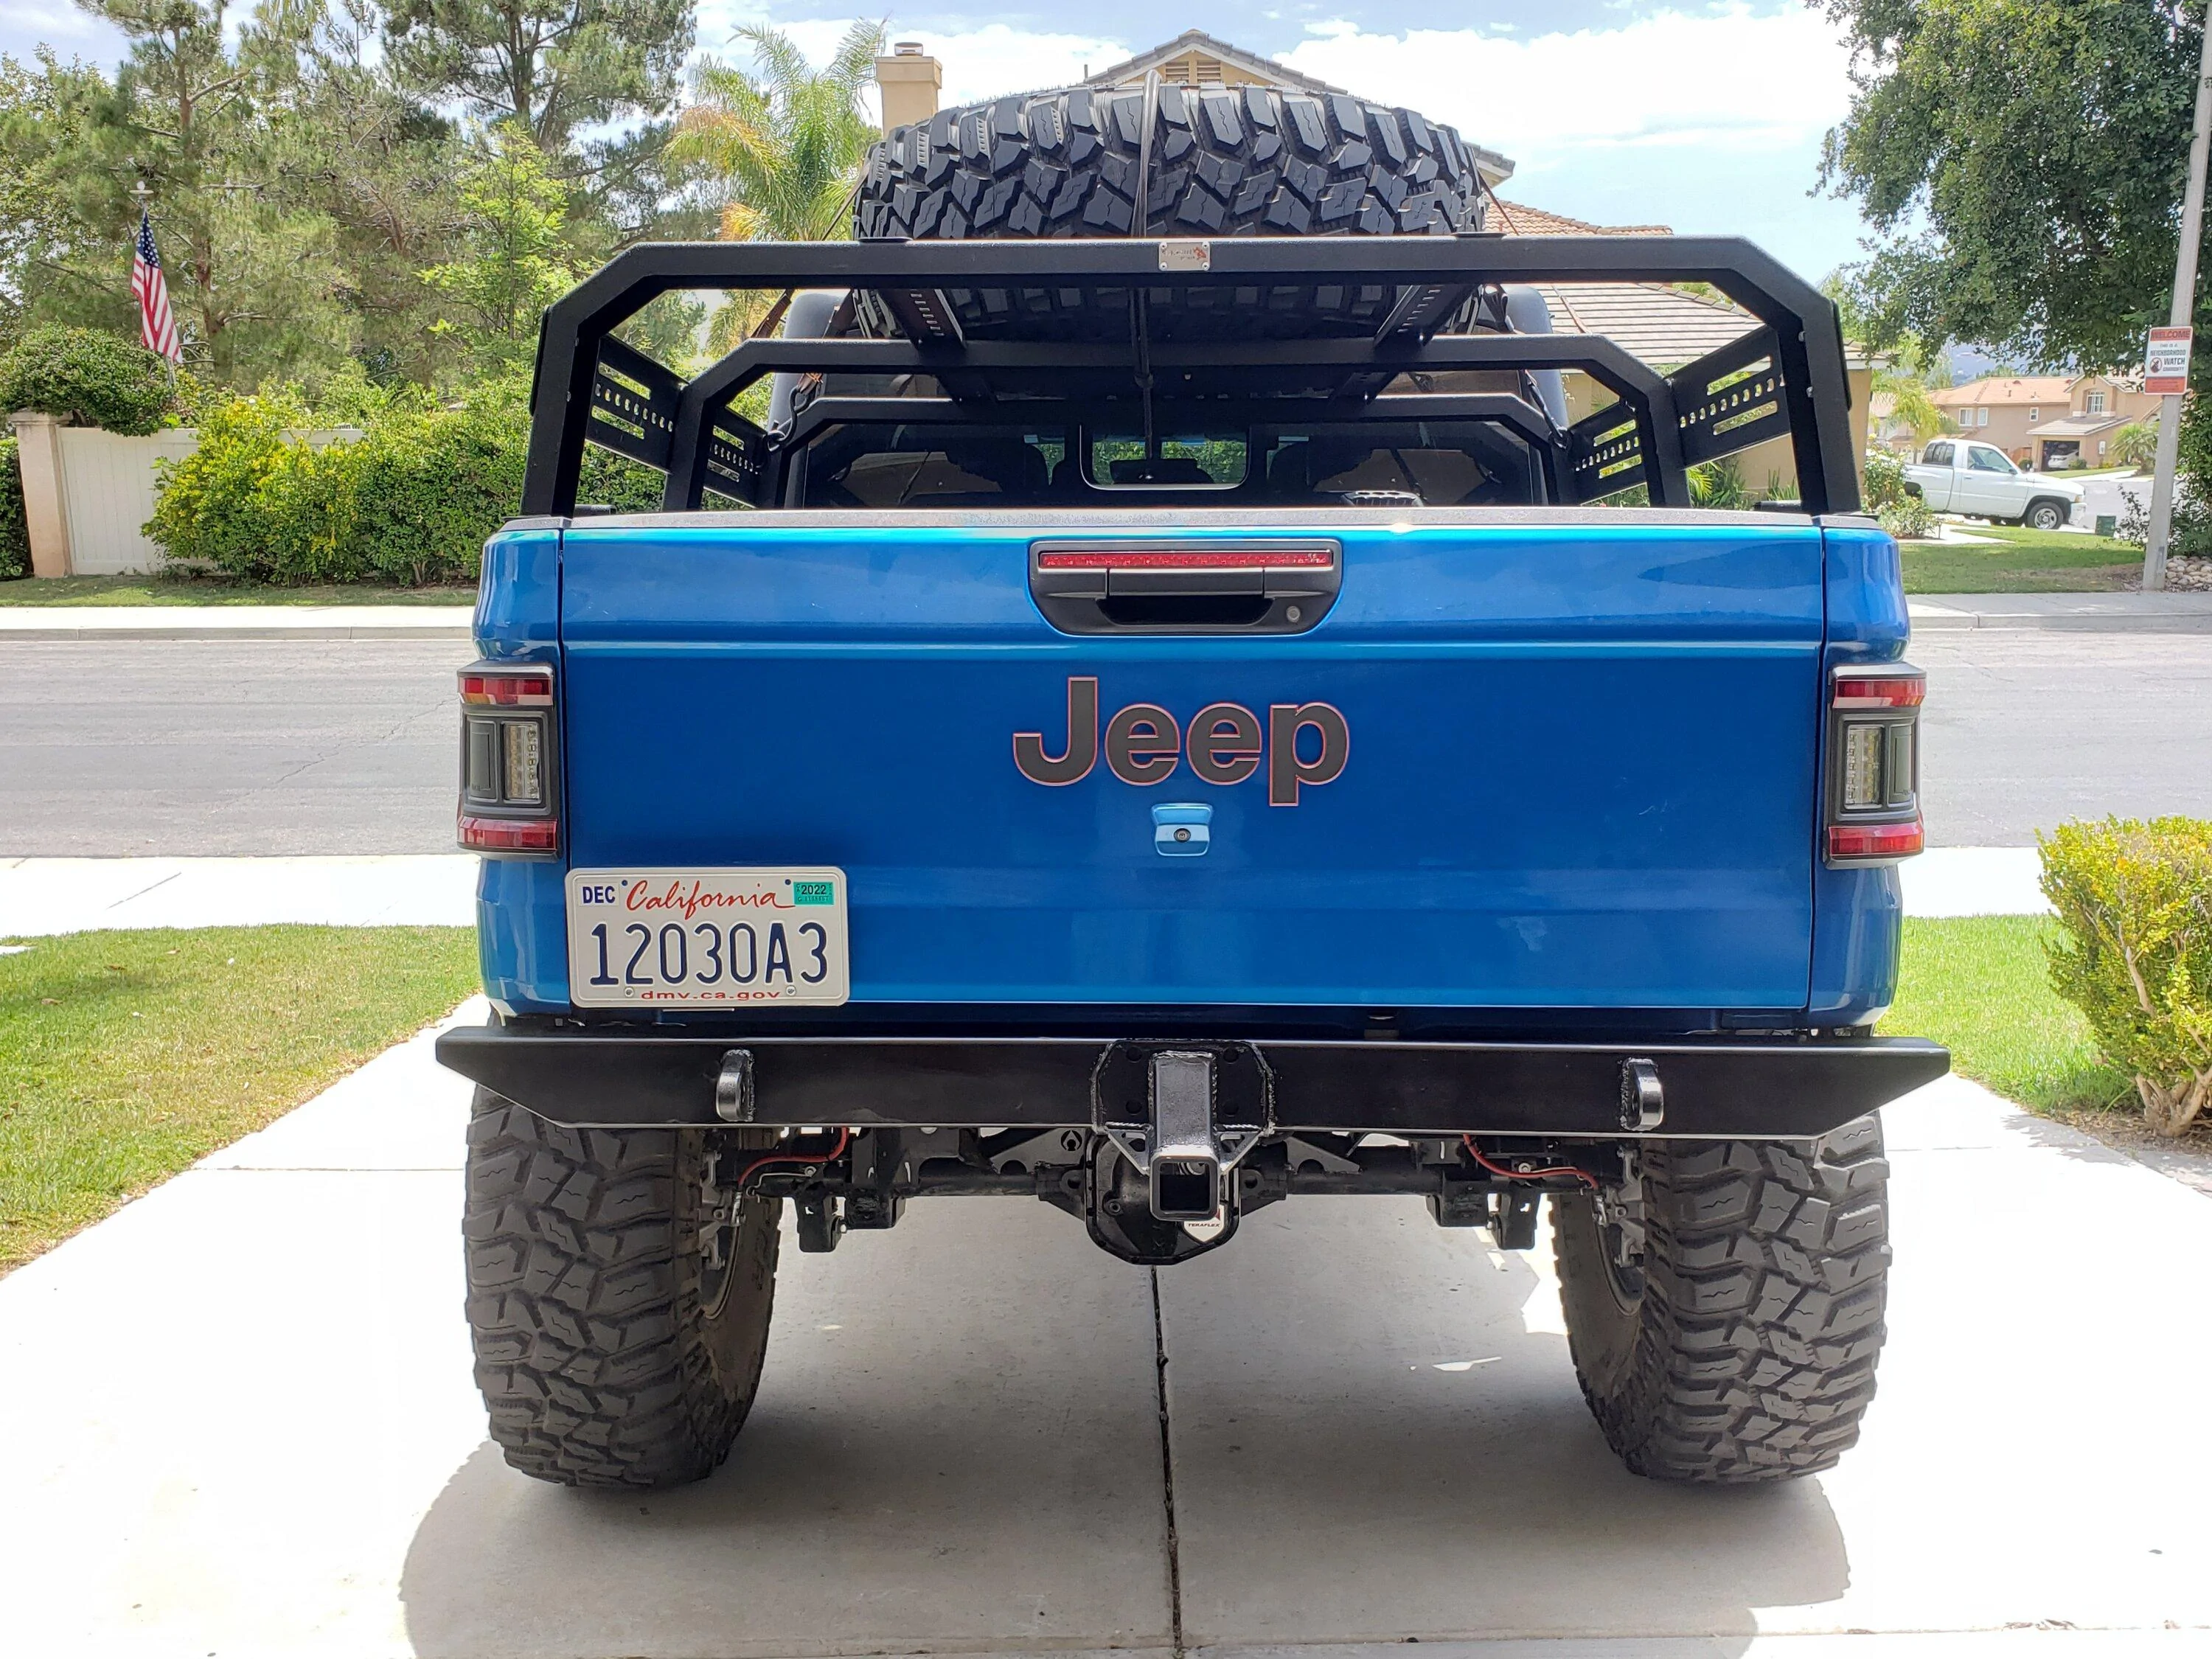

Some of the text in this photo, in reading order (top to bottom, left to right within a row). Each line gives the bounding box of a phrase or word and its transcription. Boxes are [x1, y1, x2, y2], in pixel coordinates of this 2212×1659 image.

[2164, 357, 2185, 366] WATCH
[1012, 676, 1349, 807] Jeep
[582, 886, 616, 904] DEC
[801, 884, 827, 895] 2022
[626, 880, 796, 920] California
[590, 922, 828, 986] 12030A3
[641, 990, 781, 1001] dmv.ca.gov
